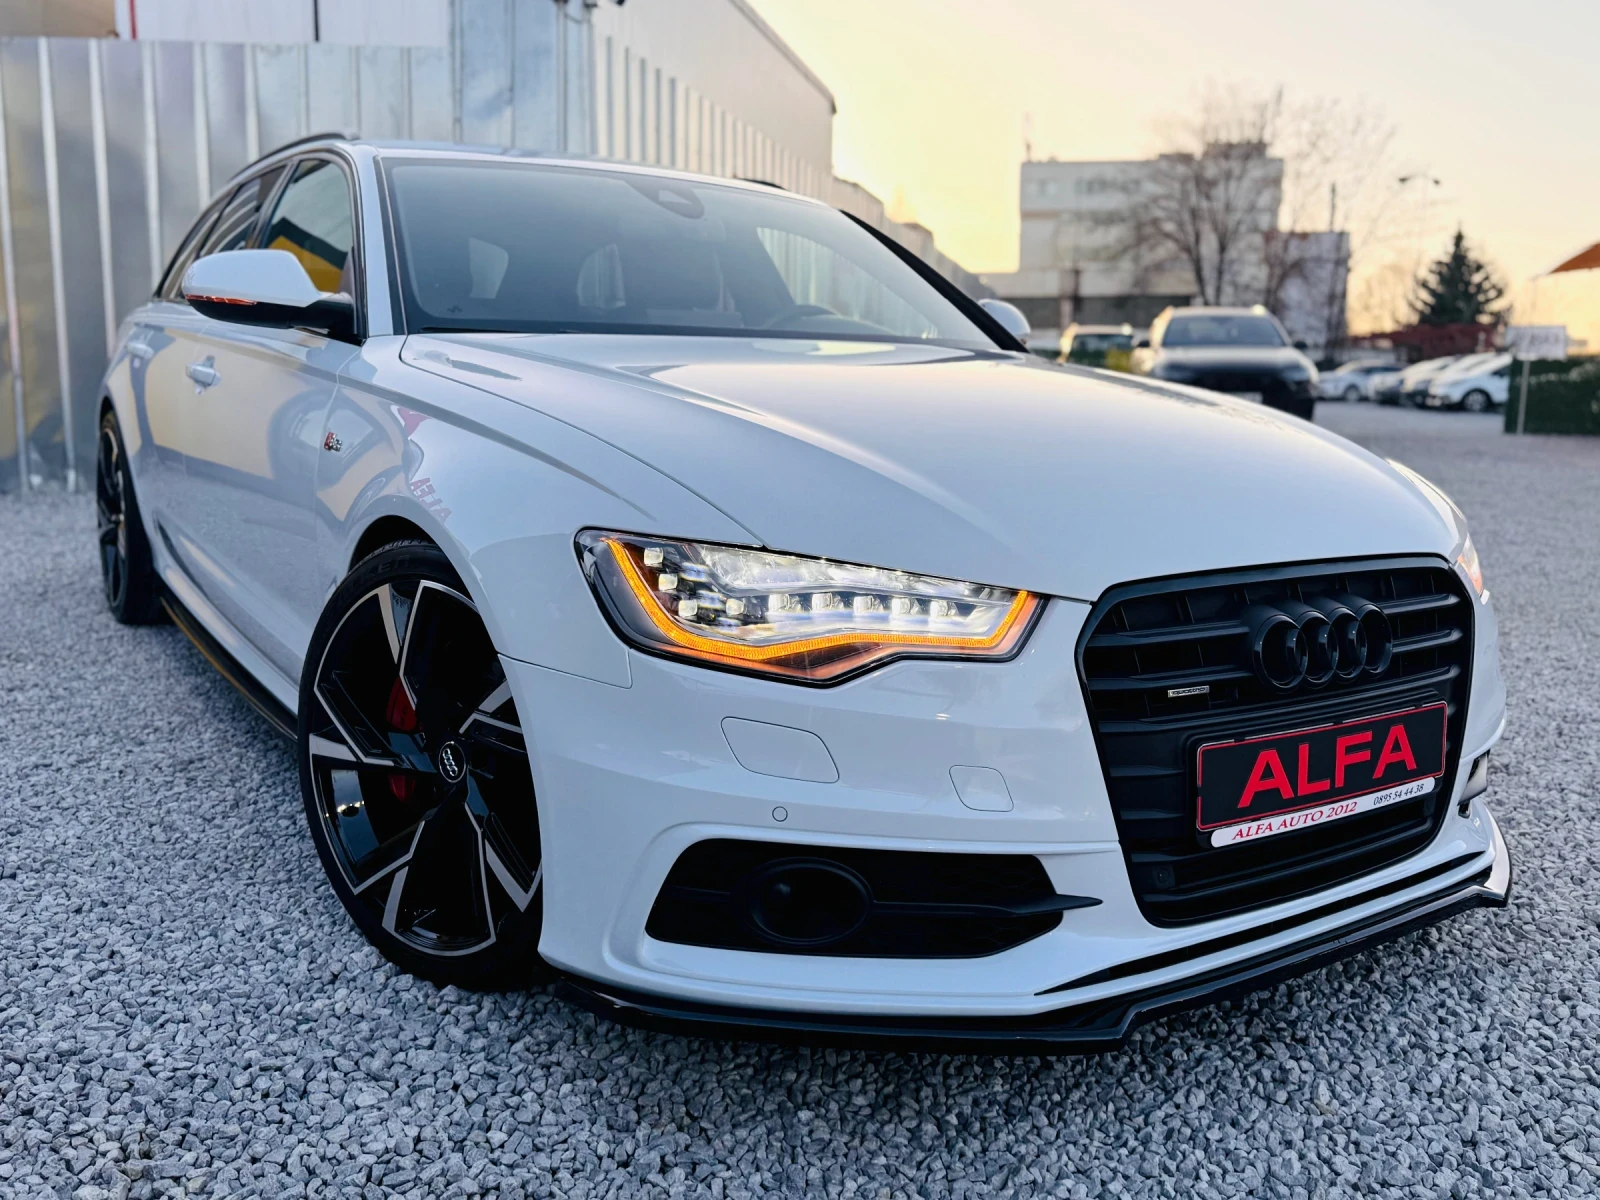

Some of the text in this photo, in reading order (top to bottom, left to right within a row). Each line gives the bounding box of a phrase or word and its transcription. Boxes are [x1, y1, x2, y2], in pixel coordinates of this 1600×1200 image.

[1237, 724, 1417, 809] ALFA
[1373, 792, 1392, 806] 0895
[1231, 801, 1358, 841] ALFA AUTO 2012
